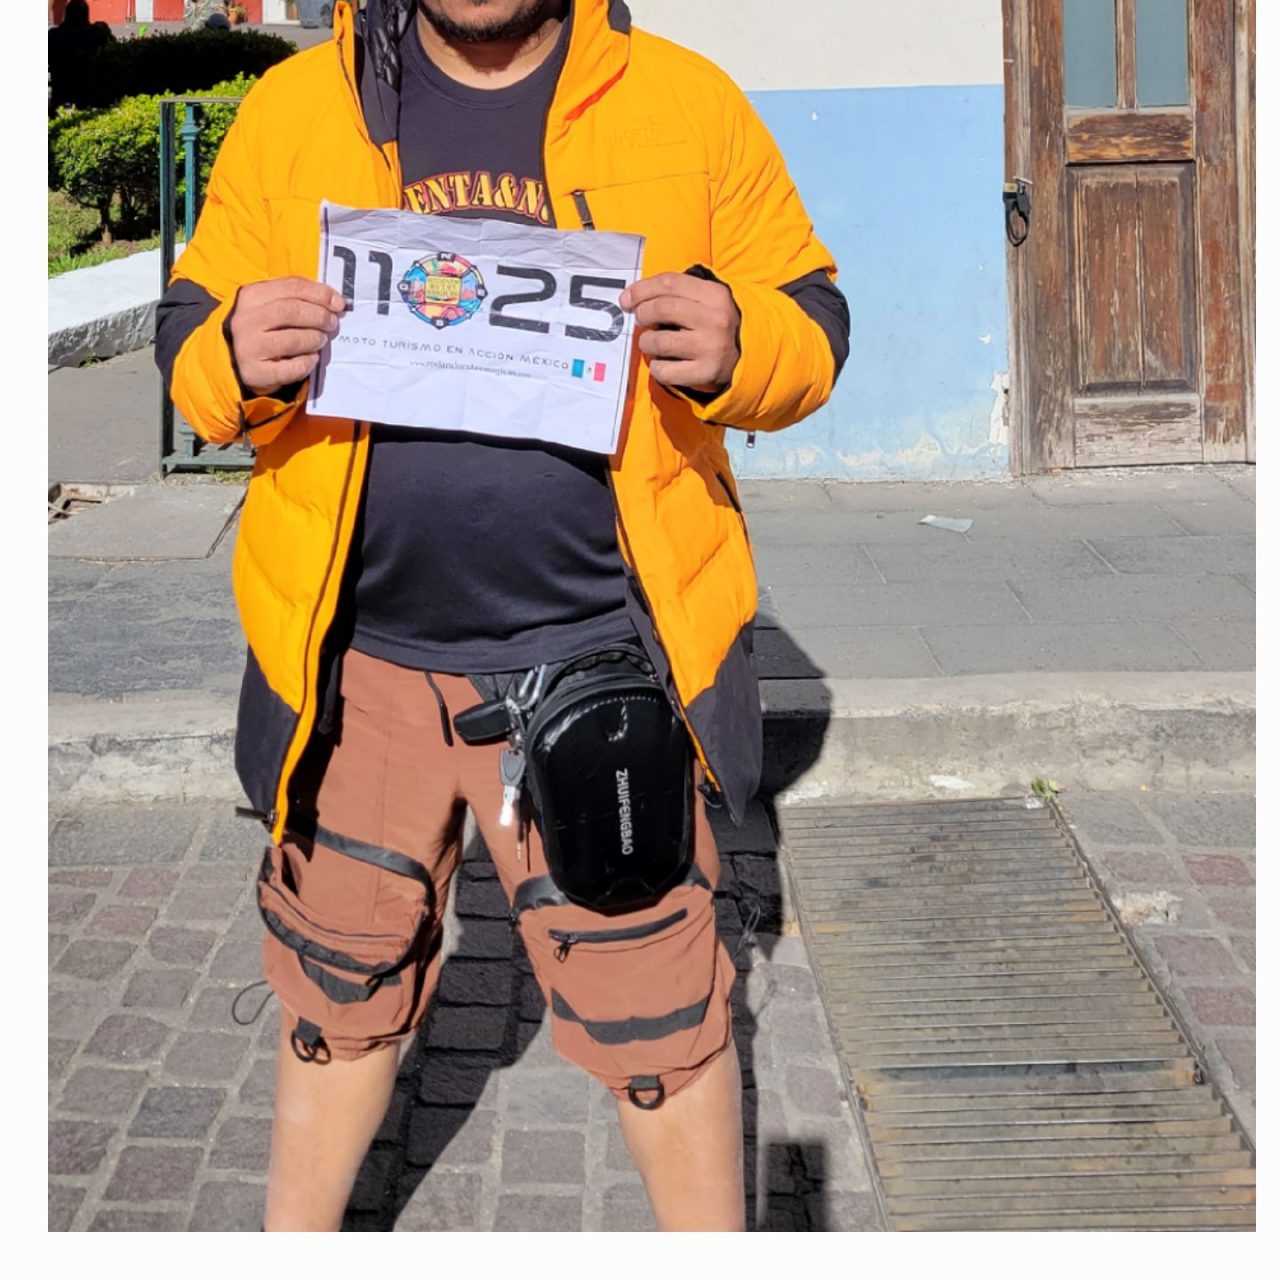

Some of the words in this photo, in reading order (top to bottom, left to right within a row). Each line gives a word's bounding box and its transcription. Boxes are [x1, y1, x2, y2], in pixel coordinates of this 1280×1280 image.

[332, 244, 393, 316] 11
[488, 264, 627, 343] 25
[338, 334, 377, 347] MOTO
[383, 339, 442, 353] TURISMO
[446, 344, 464, 355] EN
[615, 767, 634, 856] ZHUIFENGBAO
